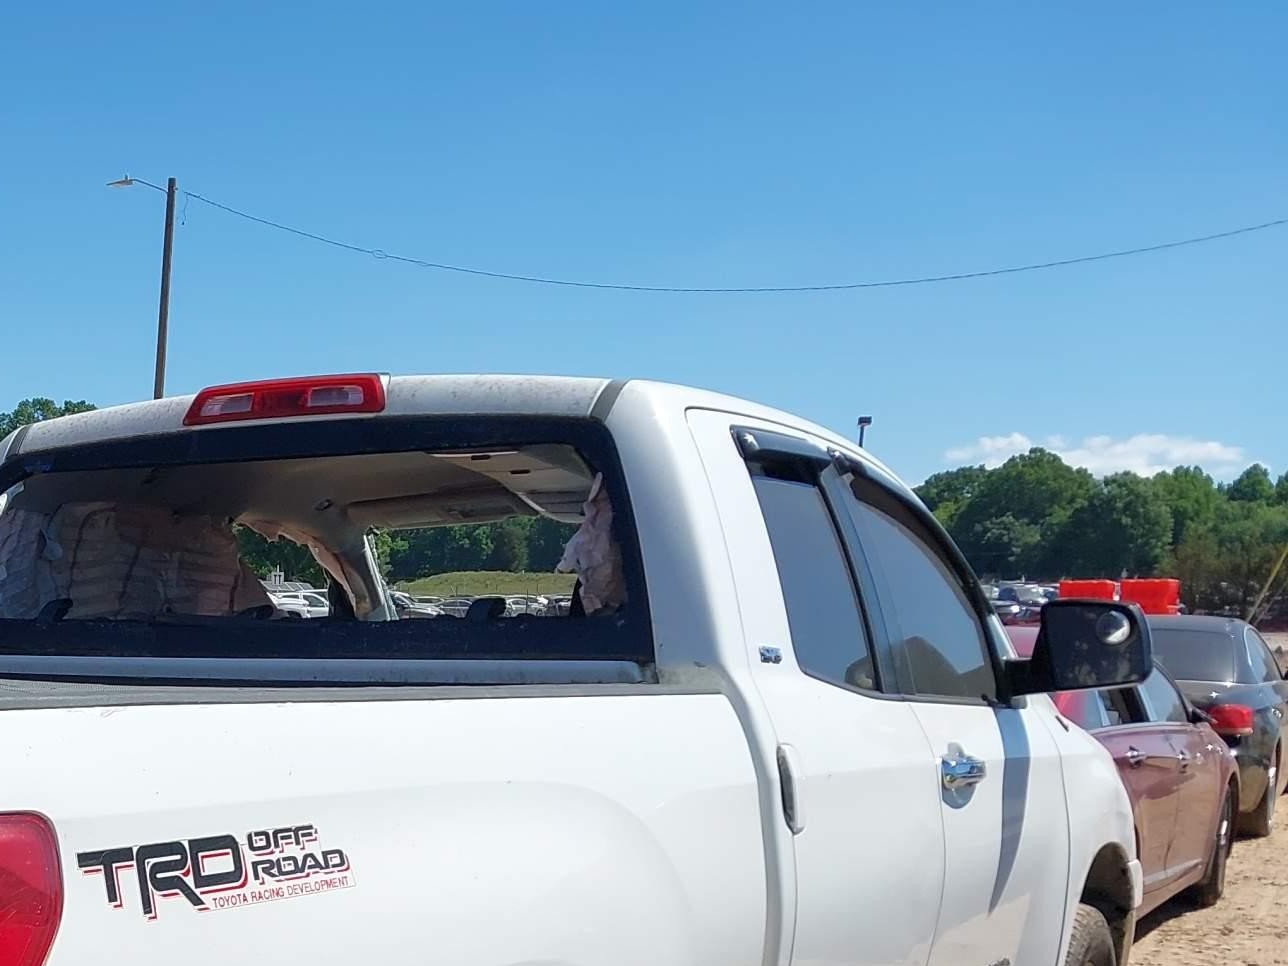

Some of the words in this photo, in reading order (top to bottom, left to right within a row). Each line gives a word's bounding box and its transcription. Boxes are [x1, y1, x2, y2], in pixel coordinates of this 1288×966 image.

[247, 824, 318, 857] OFF
[77, 834, 249, 920] TRD
[251, 849, 351, 886] ROAD
[212, 895, 250, 909] TOYOTA
[250, 887, 286, 903] RACING
[287, 875, 350, 896] DEVELOPMENT
